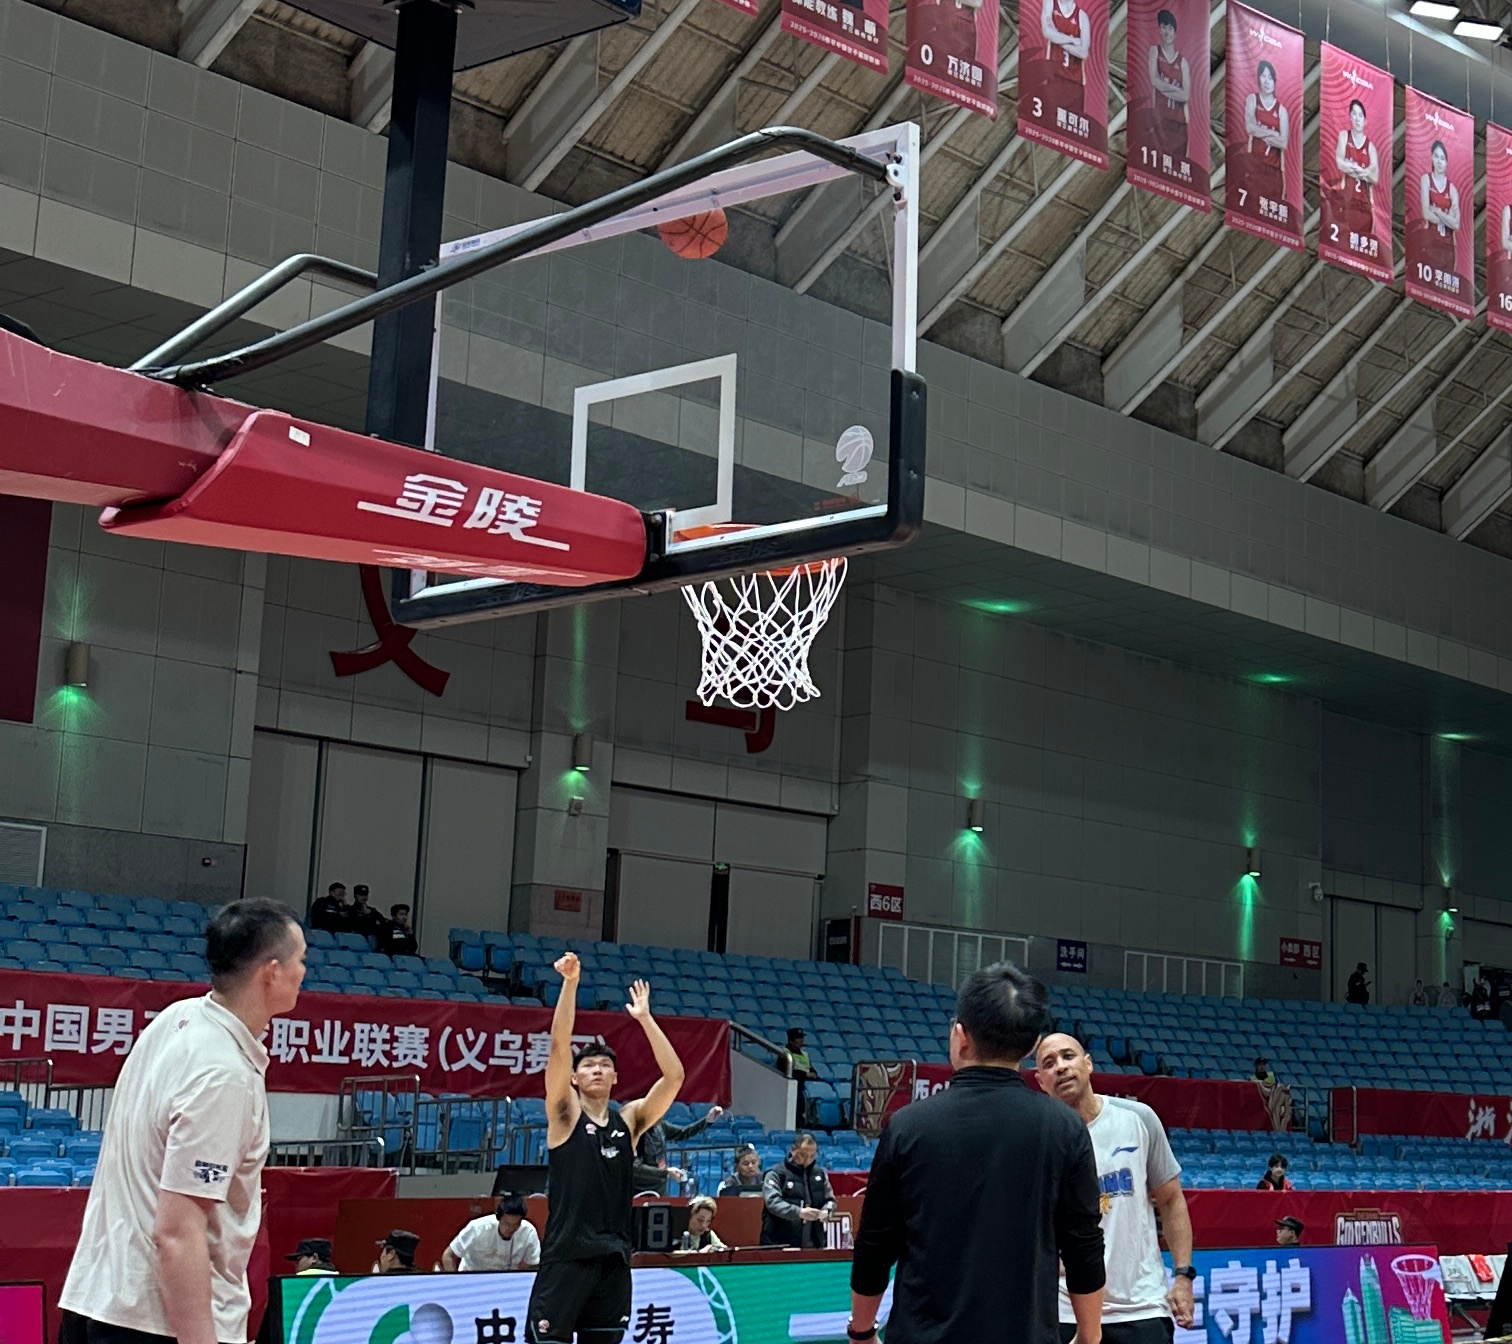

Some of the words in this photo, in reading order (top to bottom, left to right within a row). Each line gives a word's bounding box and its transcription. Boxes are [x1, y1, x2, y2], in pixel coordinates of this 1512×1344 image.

[921, 44, 933, 65] 0
[1032, 97, 1042, 117] 3
[1141, 146, 1157, 168] 11
[1238, 188, 1248, 206] 7
[1330, 223, 1340, 242] 2
[1416, 262, 1433, 282] 10
[357, 473, 571, 552] 金陵
[869, 894, 903, 913] 西6区
[0, 999, 607, 1076] 中国男职业联赛(义乌赛
